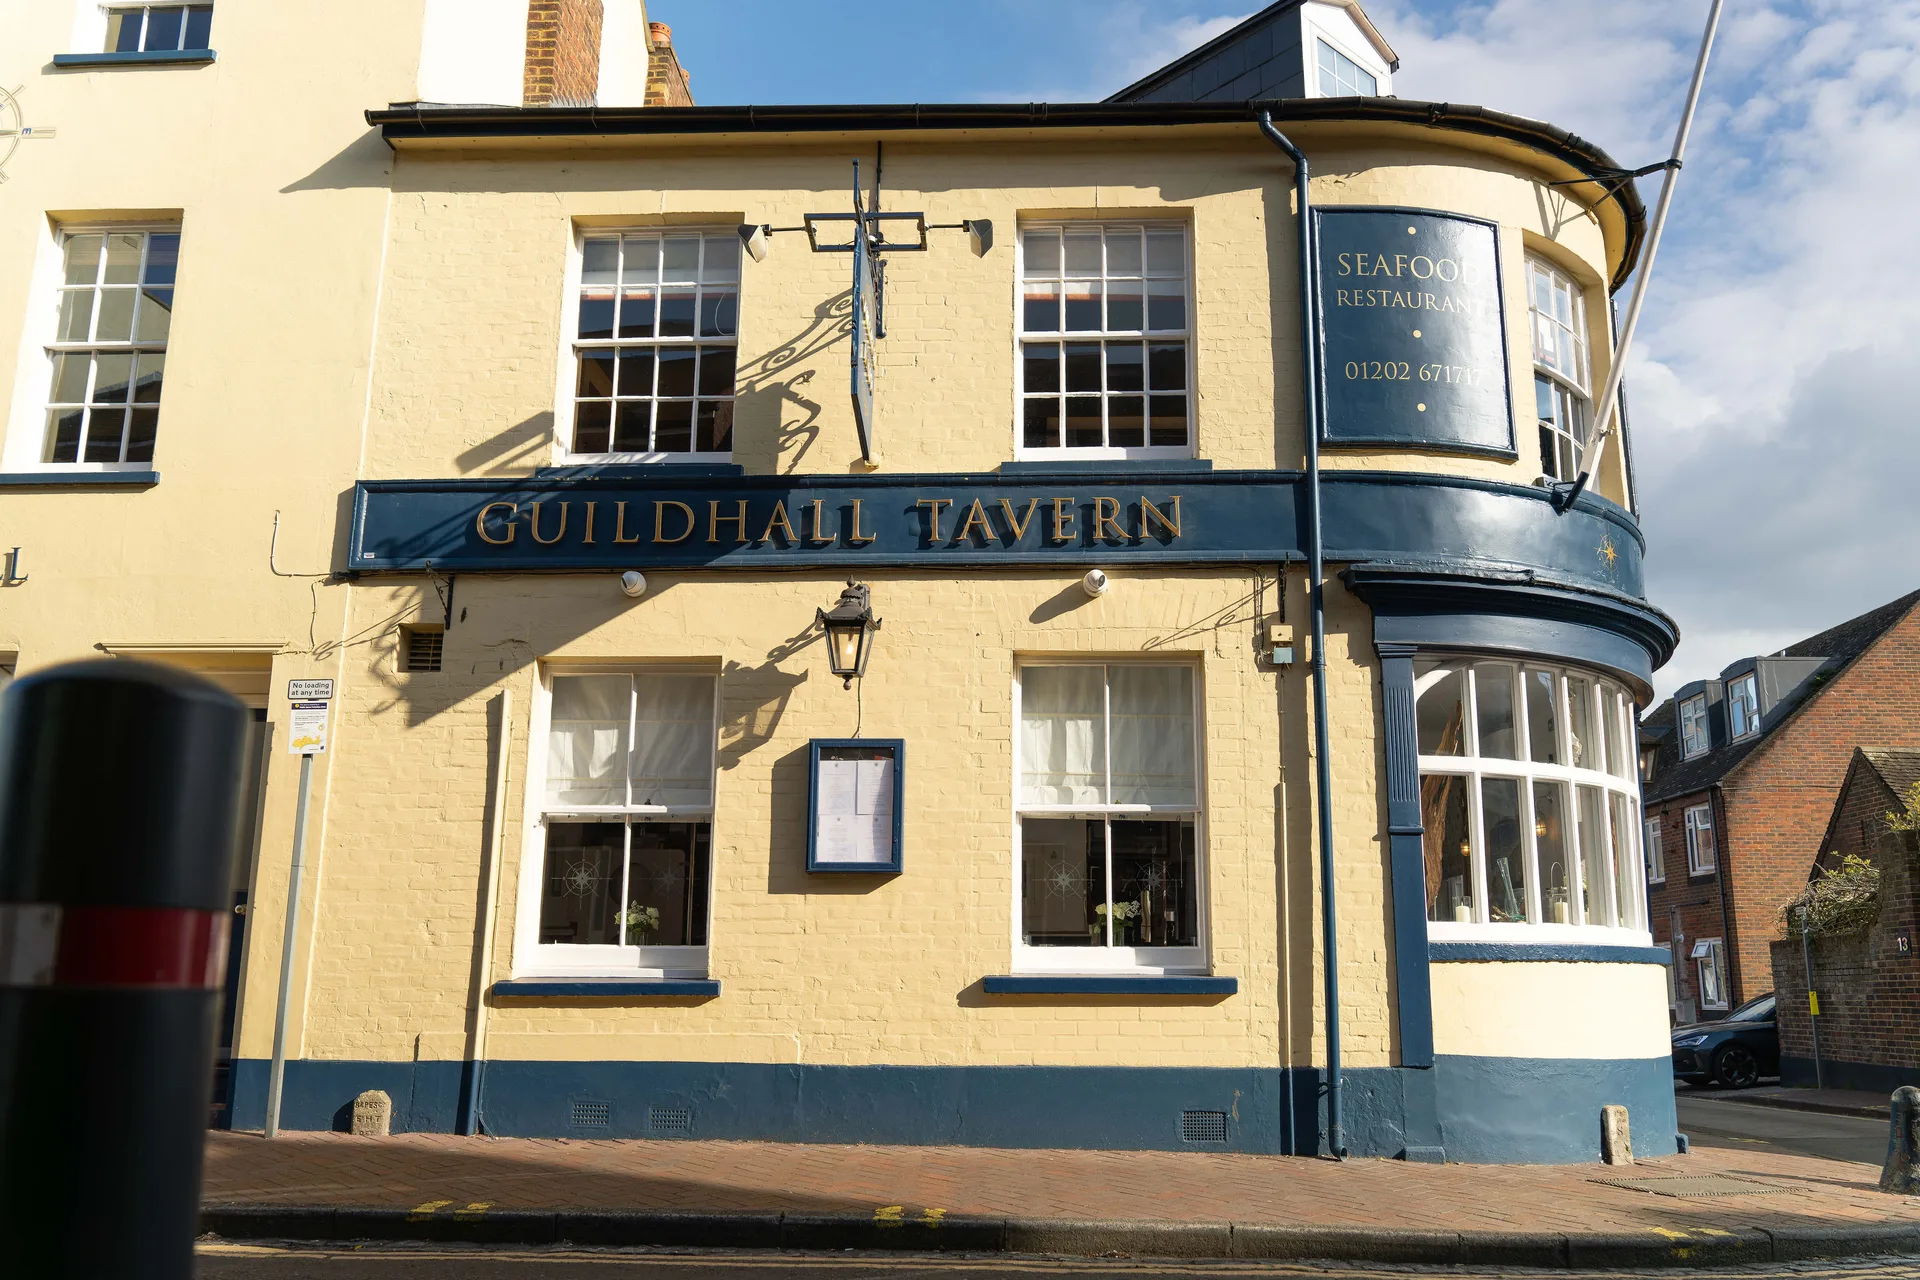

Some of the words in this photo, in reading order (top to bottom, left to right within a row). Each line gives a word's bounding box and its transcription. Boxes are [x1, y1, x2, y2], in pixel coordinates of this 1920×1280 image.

[1337, 252, 1483, 286] SEAFOOD
[1336, 289, 1487, 318] RESTAURANT
[1345, 361, 1411, 381] 01202
[1419, 363, 1483, 387] 671717
[476, 498, 877, 545] GUILDHALL
[915, 495, 1183, 542] TAVERN
[304, 682, 330, 690] loading
[1896, 937, 1908, 952] 13
